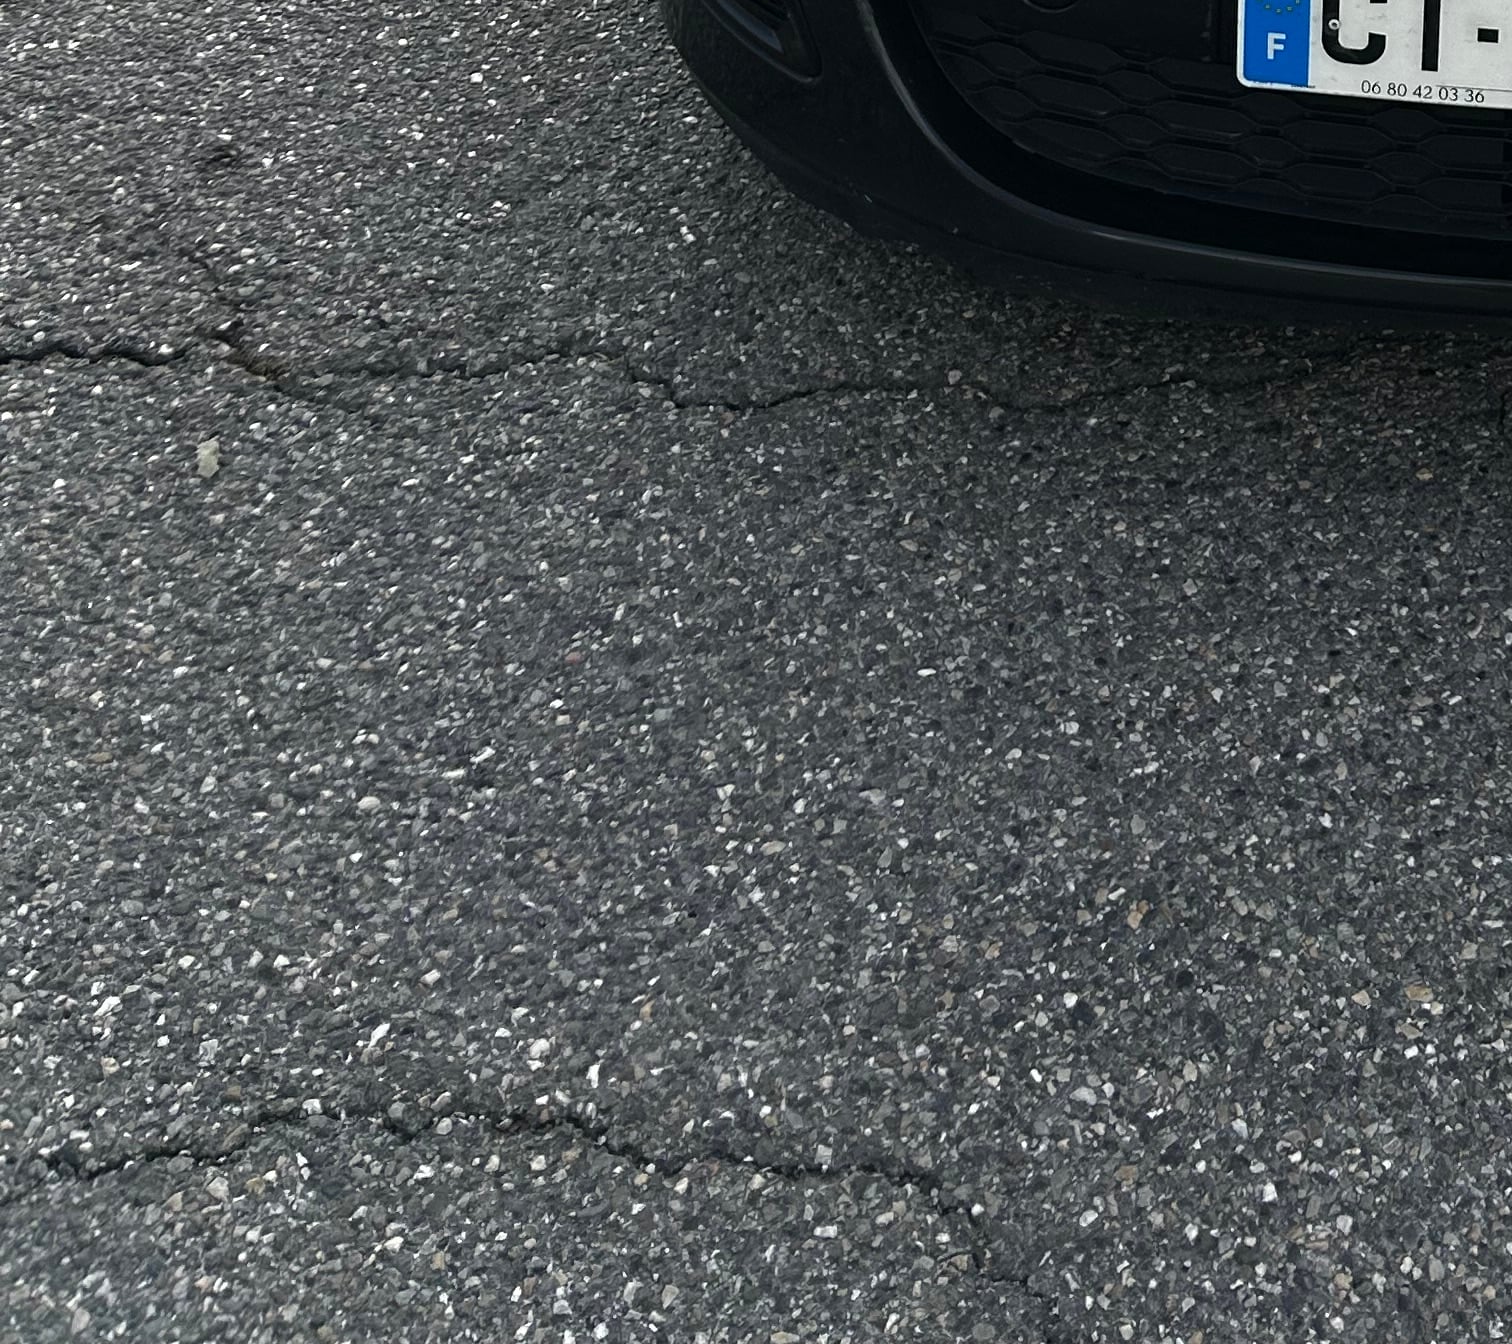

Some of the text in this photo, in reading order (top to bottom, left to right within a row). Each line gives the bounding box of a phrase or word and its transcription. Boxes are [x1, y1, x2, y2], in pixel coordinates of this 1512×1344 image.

[1267, 32, 1286, 60] F
[1361, 80, 1485, 103] 06 80 42 03 36
